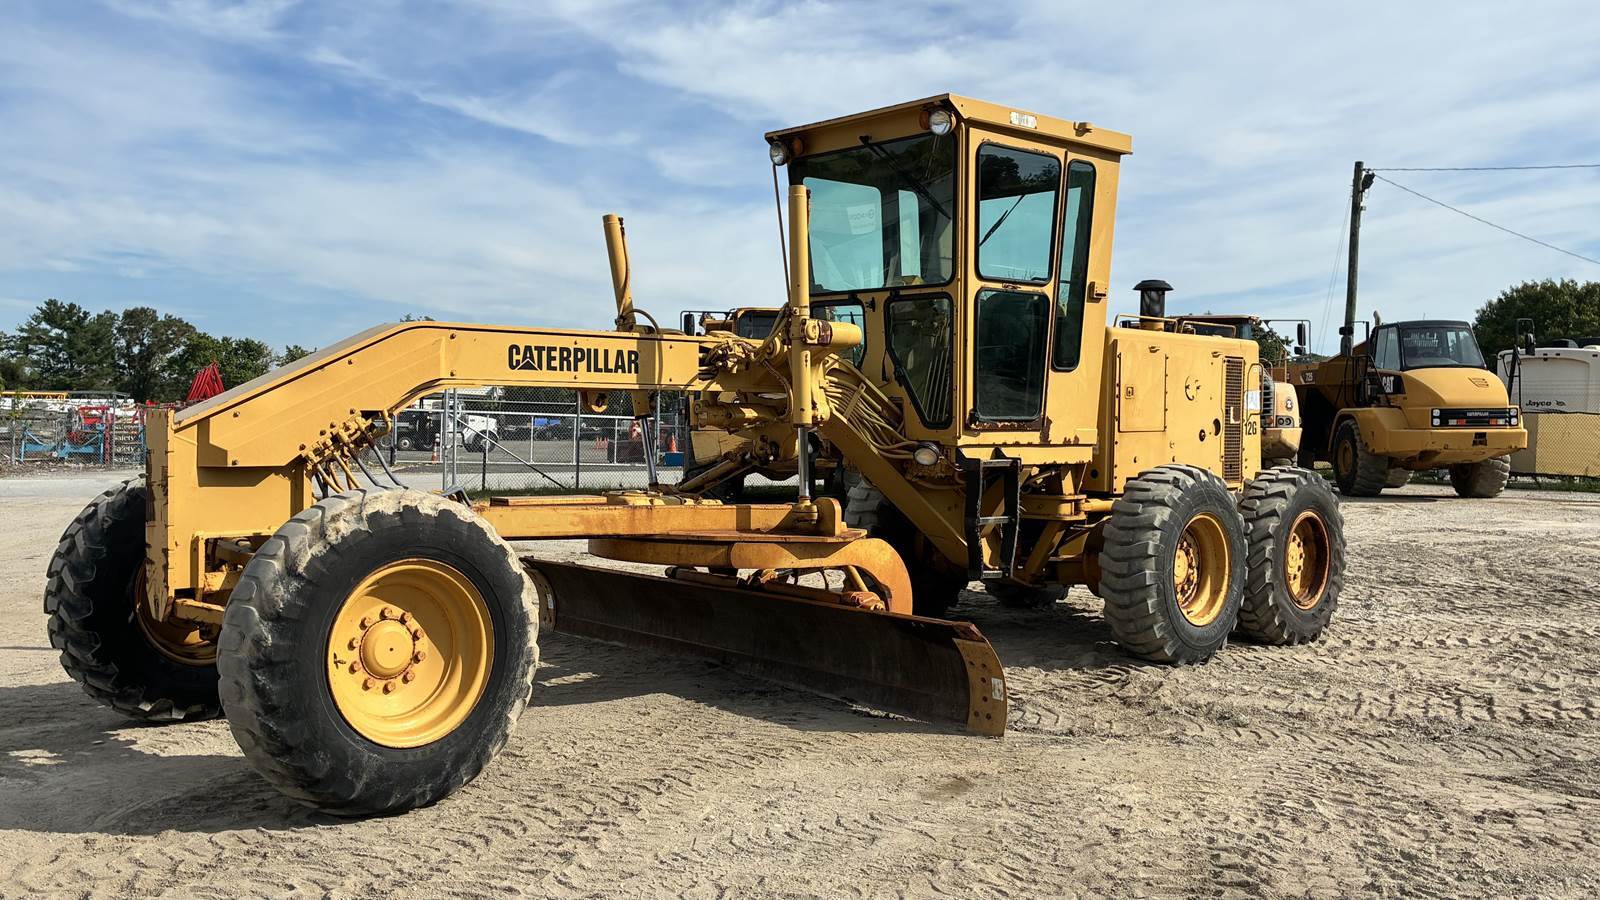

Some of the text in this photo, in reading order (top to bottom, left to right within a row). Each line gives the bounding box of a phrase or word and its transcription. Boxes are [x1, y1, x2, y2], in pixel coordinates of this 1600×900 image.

[508, 344, 639, 374] CATERPILLAR
[1382, 376, 1395, 393] CAT
[1244, 421, 1257, 436] 12G
